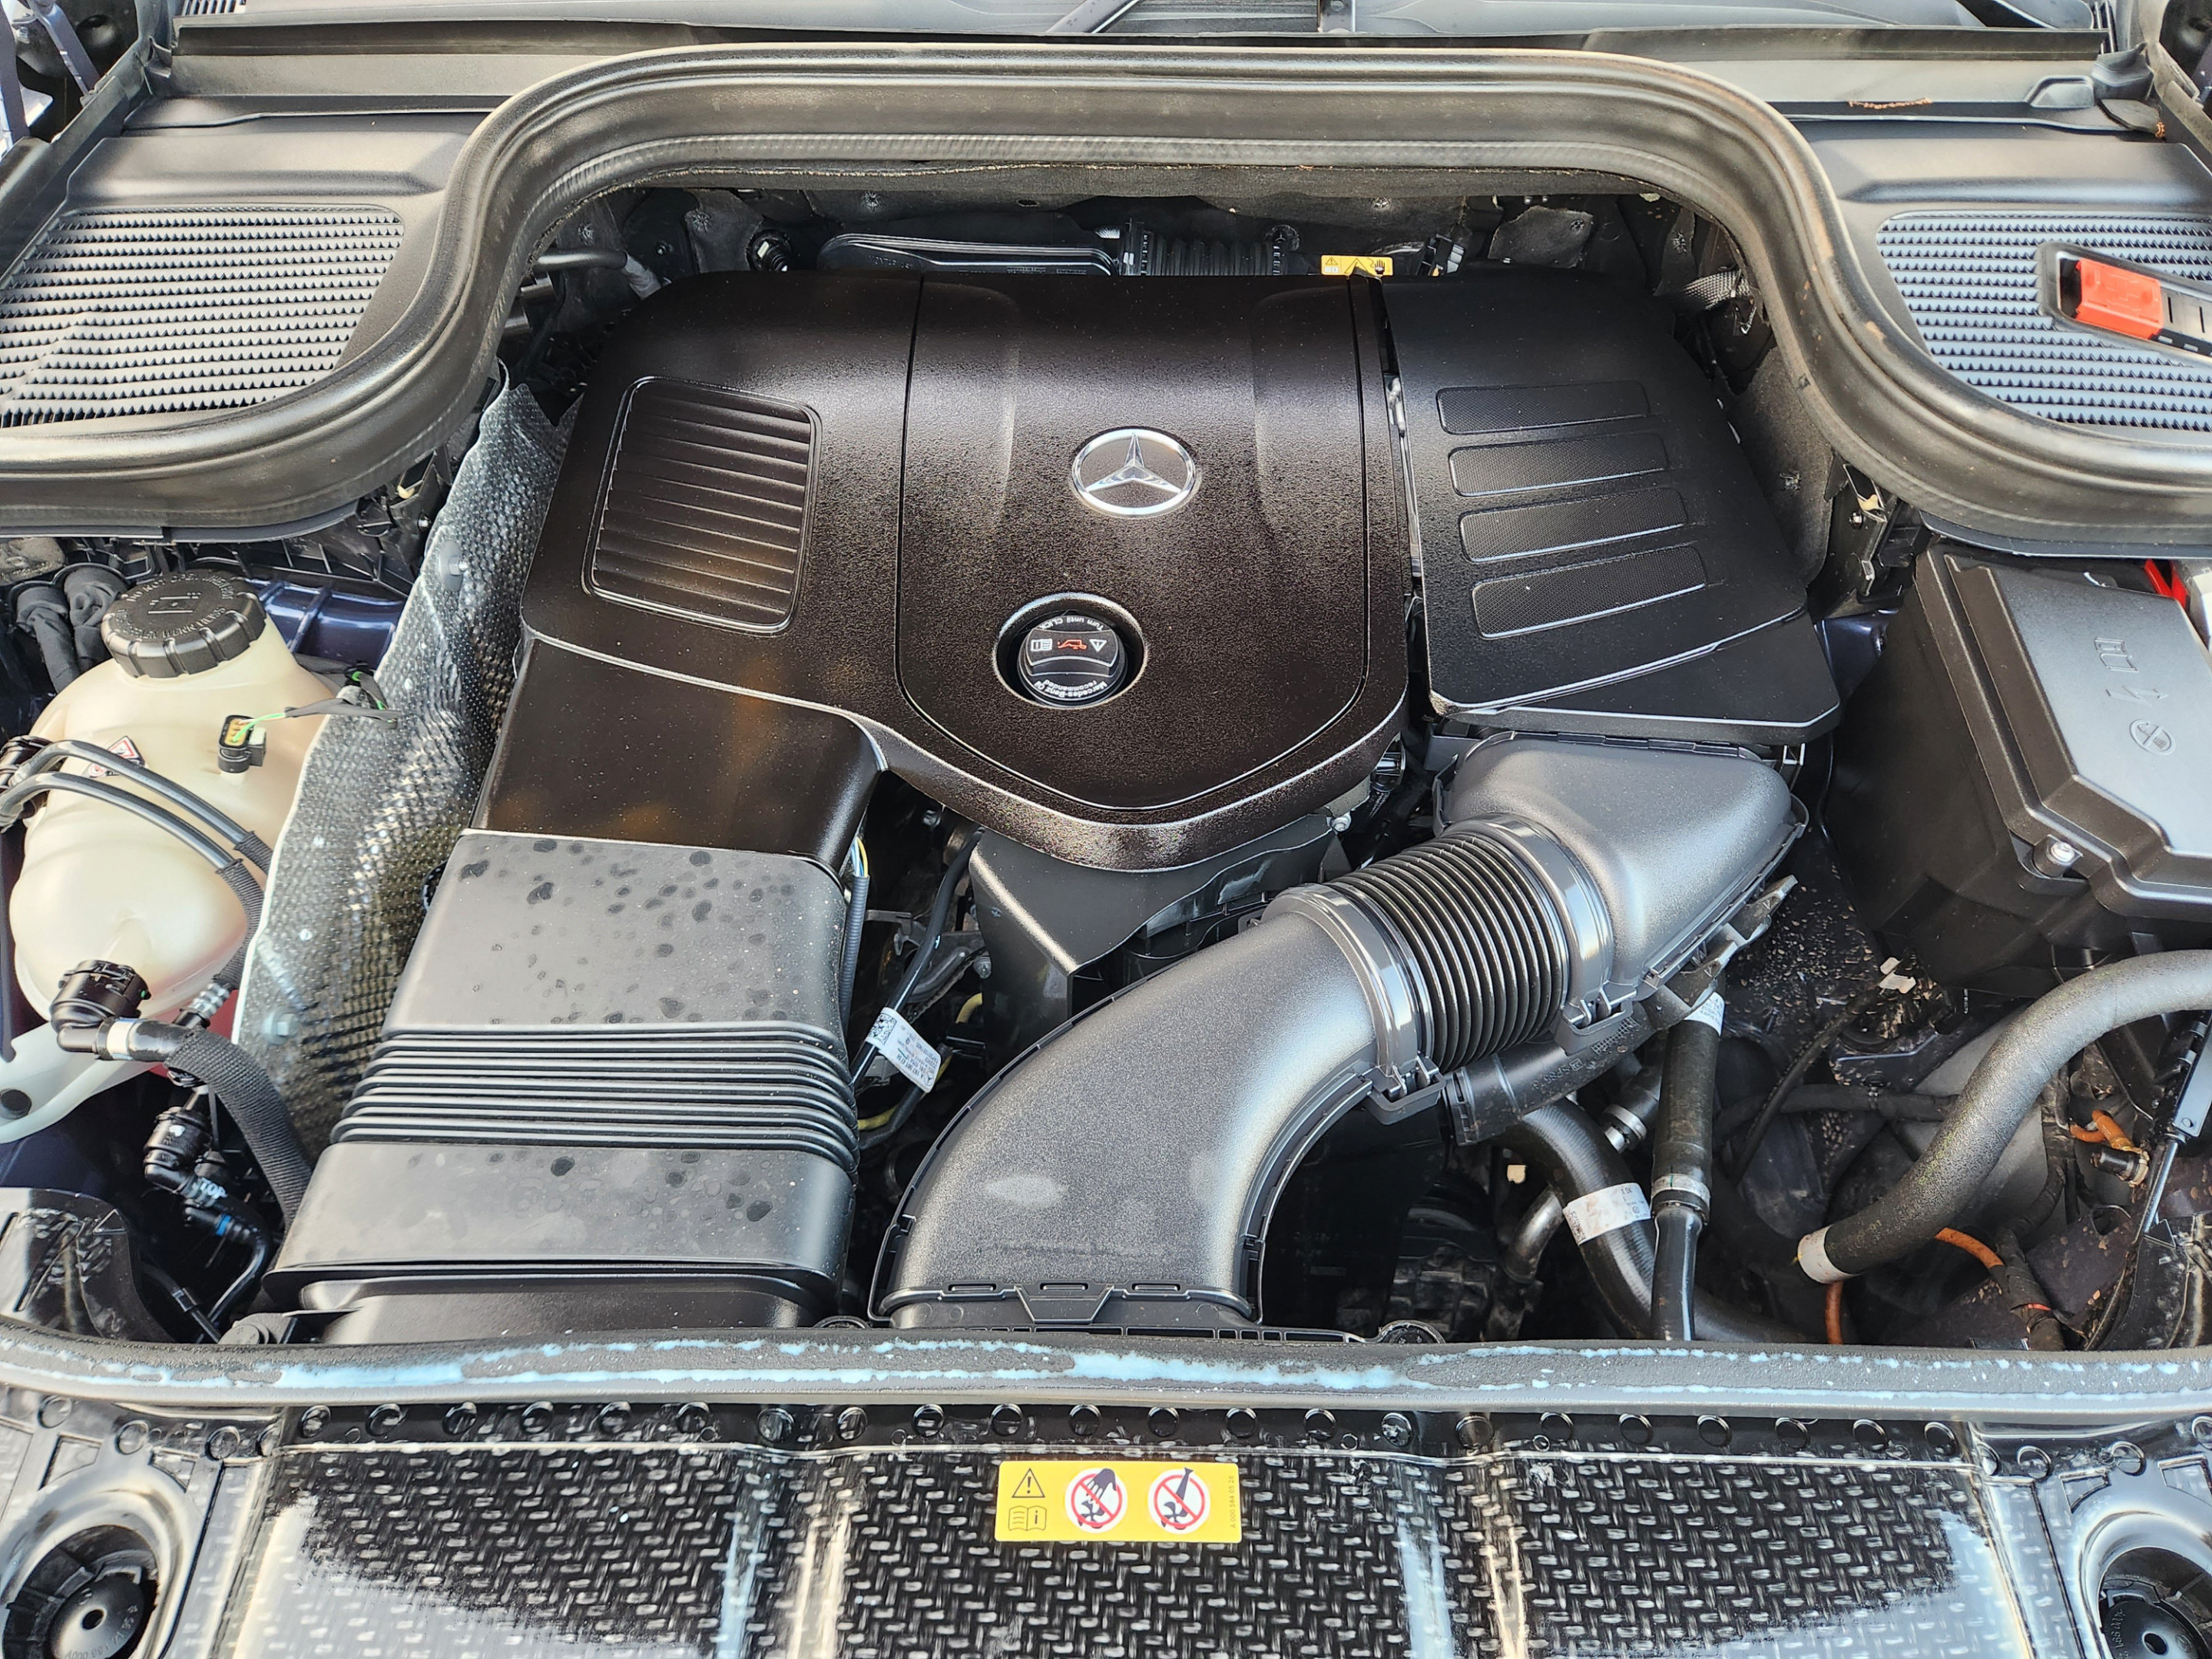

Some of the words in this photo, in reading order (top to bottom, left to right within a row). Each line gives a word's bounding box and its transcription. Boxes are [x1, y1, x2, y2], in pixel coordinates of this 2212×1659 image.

[126, 591, 143, 603] DO
[144, 578, 166, 592] NOT
[1038, 618, 1064, 629] CLICK
[1086, 619, 1105, 631] Turn
[1033, 680, 1045, 692] Oil
[1042, 679, 1098, 692] recommended
[1045, 680, 1108, 698] Mercedes-Benz
[199, 1177, 228, 1199] TOP
[1229, 1485, 1235, 1494] 05
